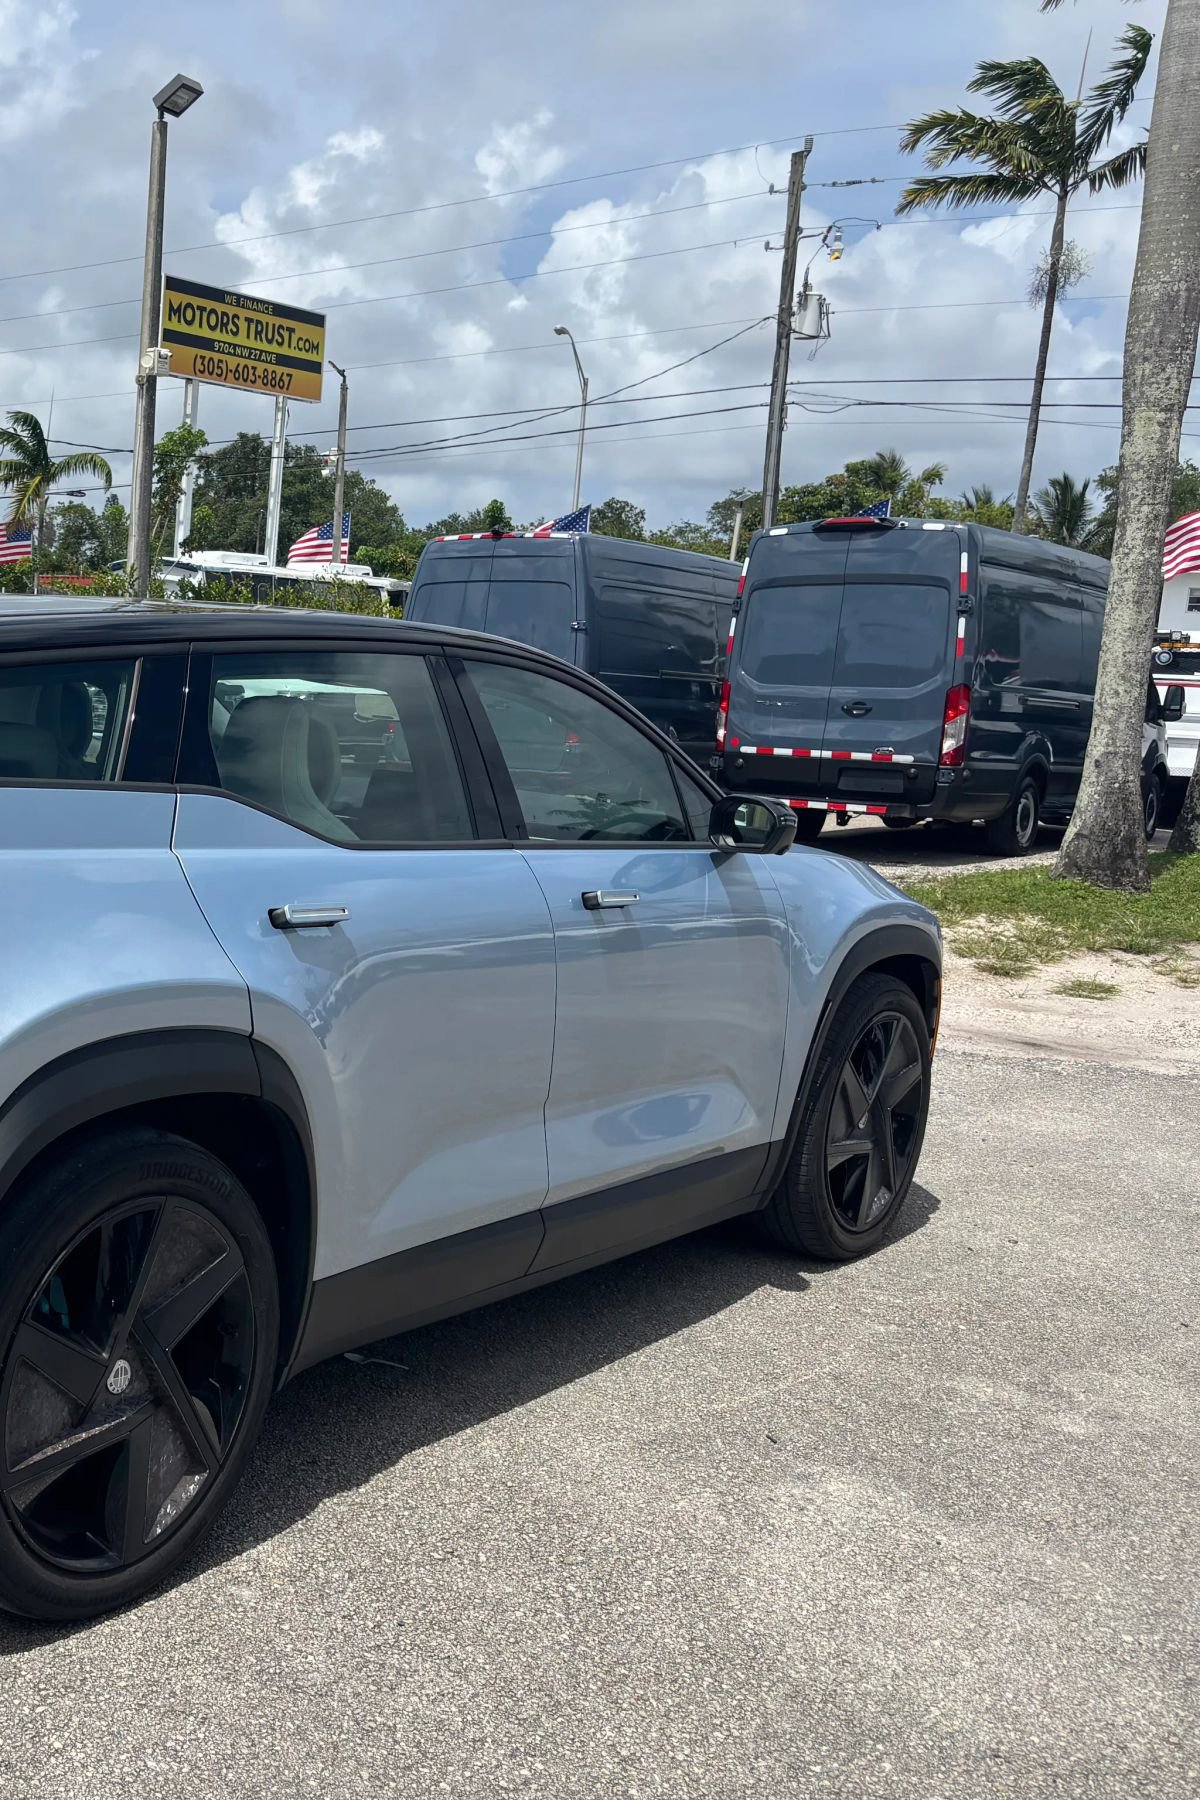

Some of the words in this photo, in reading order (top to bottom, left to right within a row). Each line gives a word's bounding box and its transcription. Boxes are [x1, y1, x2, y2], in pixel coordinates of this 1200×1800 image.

[167, 299, 240, 337] MOTORS
[224, 293, 237, 305] WE
[240, 297, 273, 314] FINANCE
[213, 341, 234, 355] 9704
[235, 345, 250, 358] NW
[250, 349, 260, 360] 27
[260, 352, 277, 363] AVE
[193, 353, 293, 391] (305)-603-8867
